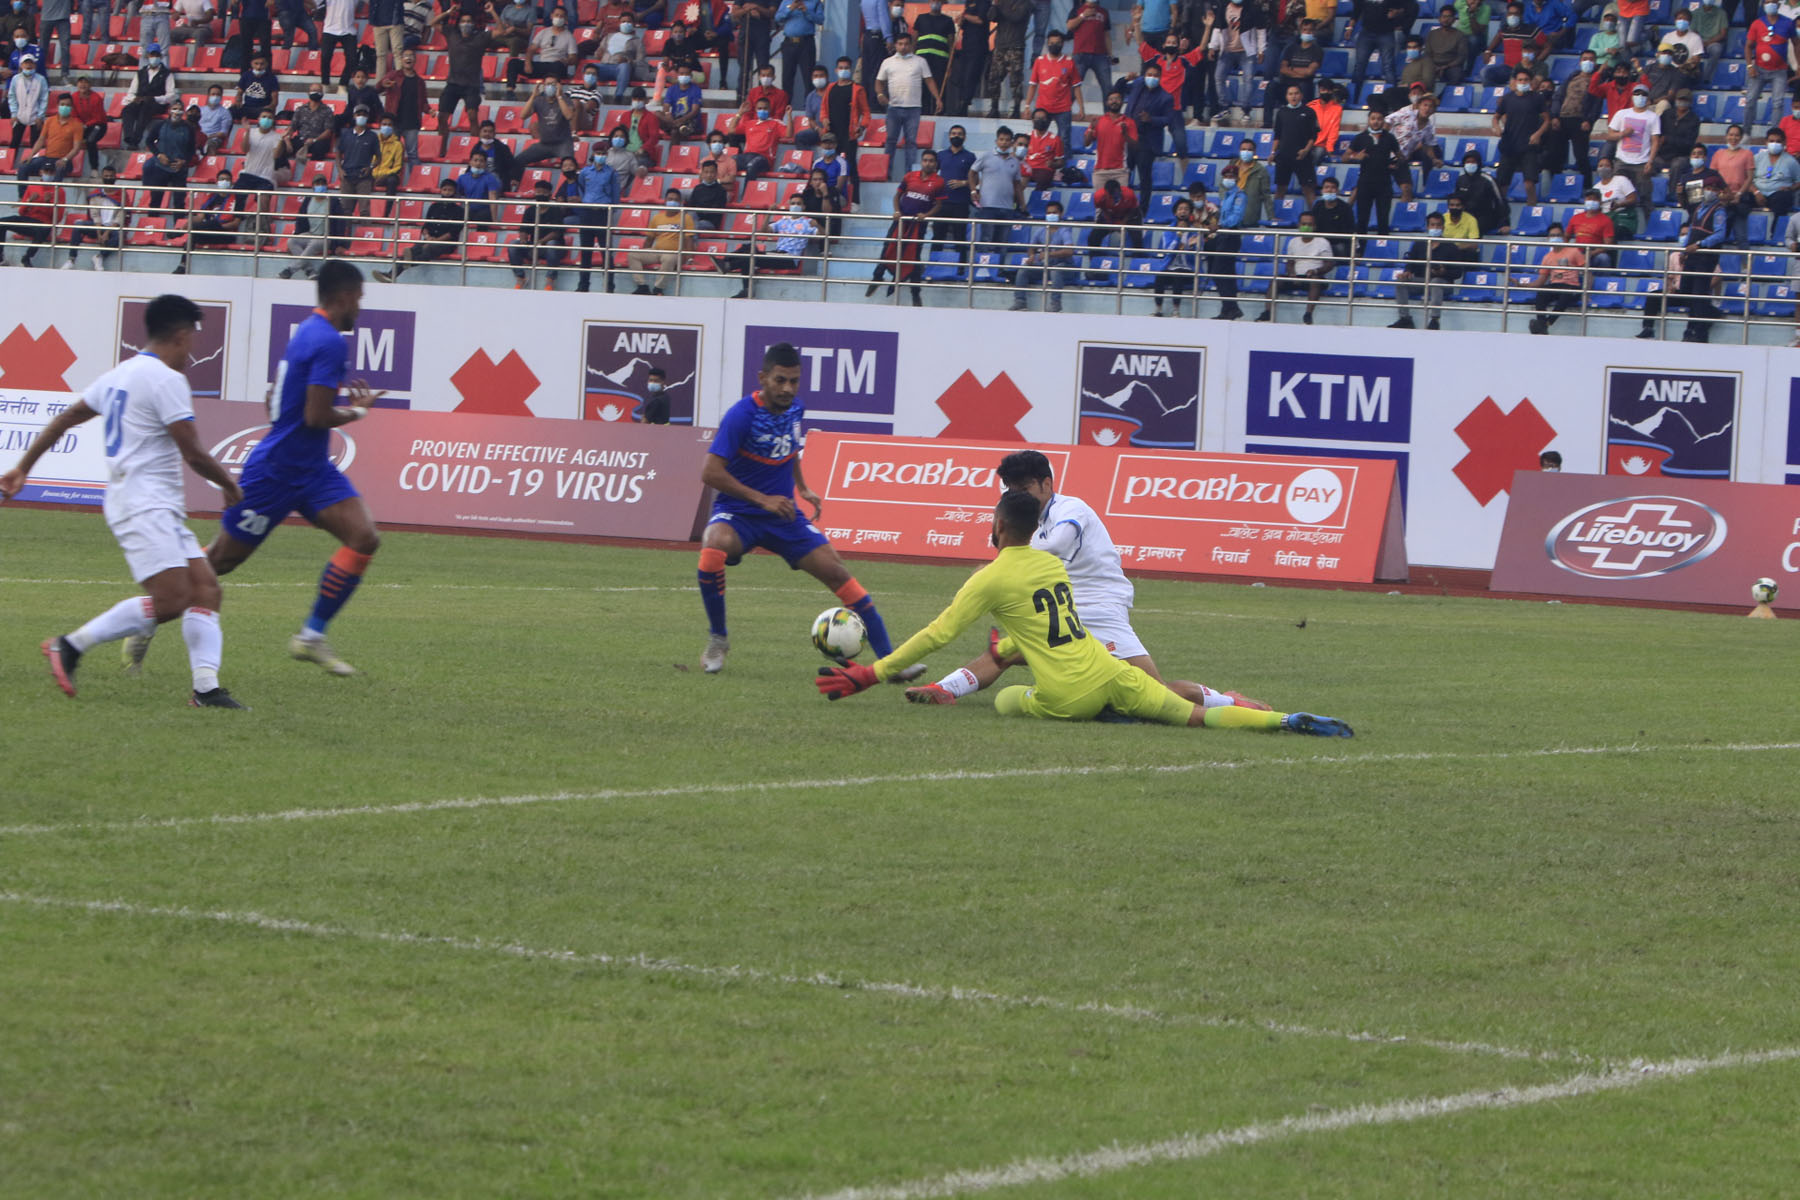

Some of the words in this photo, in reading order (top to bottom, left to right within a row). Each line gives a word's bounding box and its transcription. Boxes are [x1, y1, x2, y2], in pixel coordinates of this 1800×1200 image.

[613, 331, 672, 355] ANFA
[764, 345, 877, 395] TM
[1110, 353, 1174, 378] ANFA
[1268, 371, 1391, 423] KTM
[1639, 379, 1707, 403] ANFA
[0, 430, 78, 454] LIMED
[410, 439, 481, 460] PROVEN
[484, 443, 568, 465] EFFECTIVE
[570, 449, 650, 469] AGAINST
[770, 434, 792, 458] 26
[399, 461, 545, 497] COVID-19
[1291, 487, 1337, 503] PAY
[237, 509, 270, 536] 20
[1566, 521, 1705, 553] Lifebuoy
[1032, 582, 1087, 649] 23
